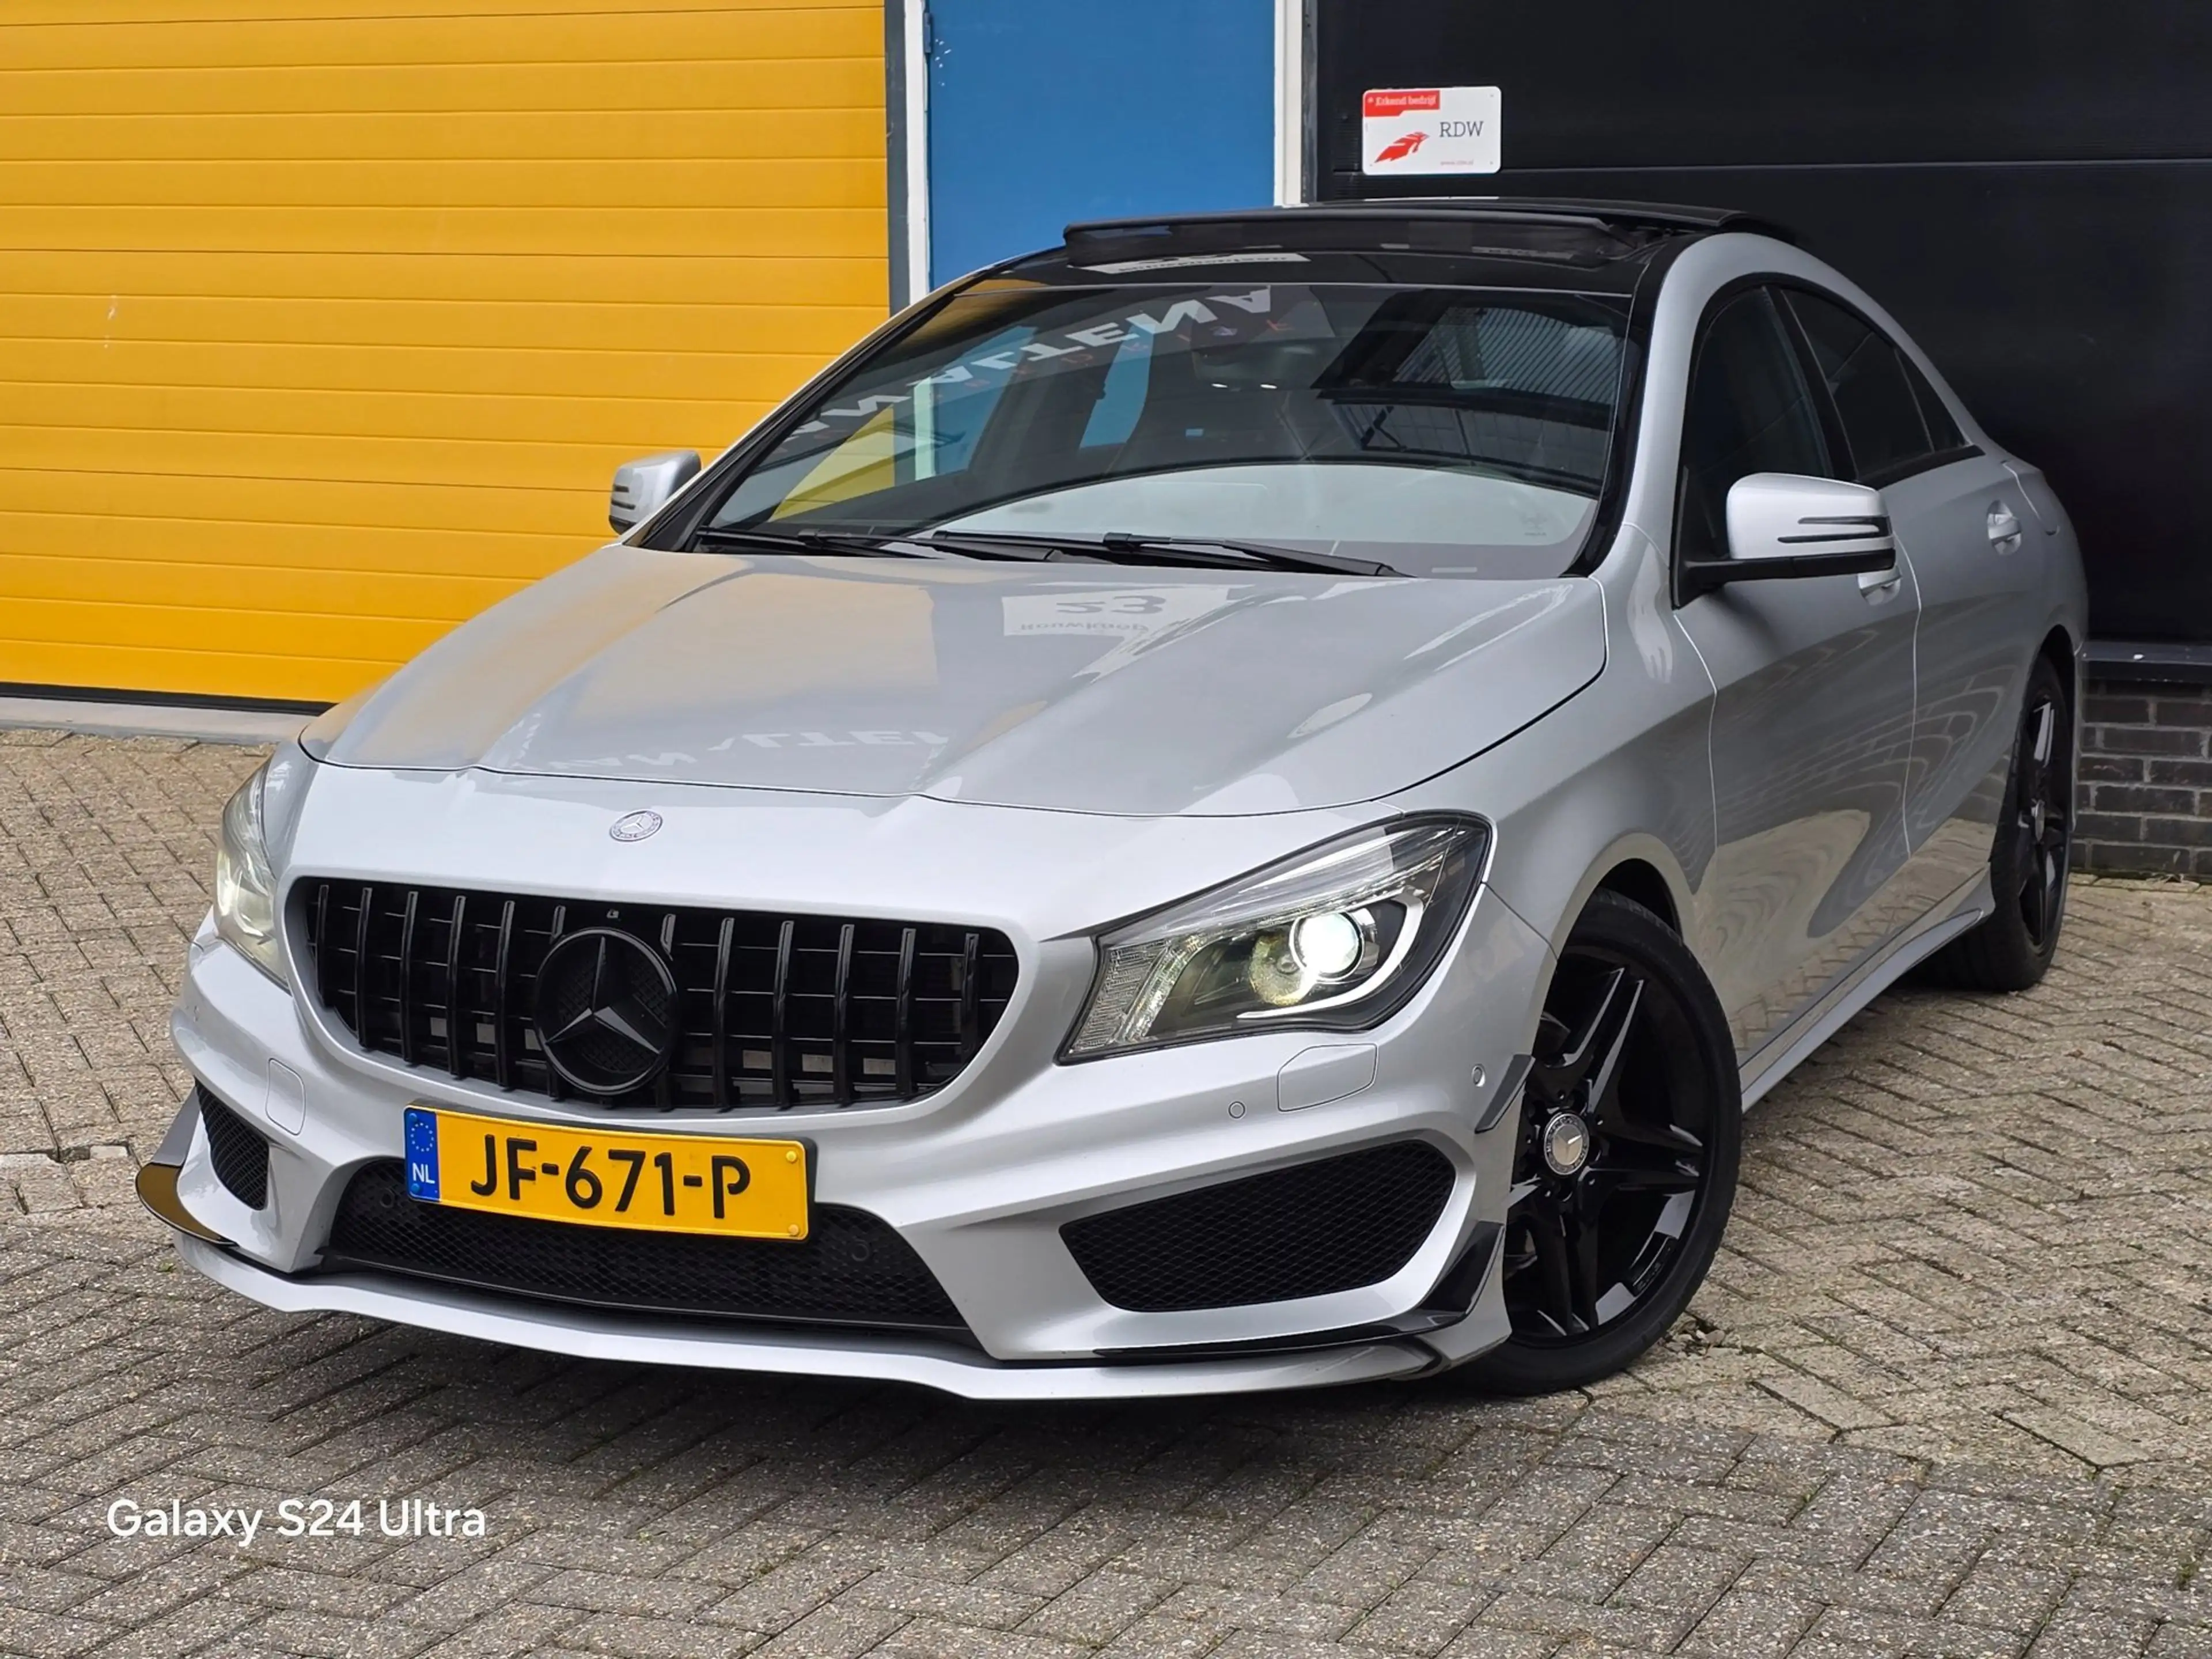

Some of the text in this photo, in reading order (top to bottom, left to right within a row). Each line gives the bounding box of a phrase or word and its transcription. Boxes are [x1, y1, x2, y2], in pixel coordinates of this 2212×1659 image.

[1440, 121, 1484, 138] RDW
[412, 1162, 435, 1184] NL
[470, 1134, 751, 1219] JF-671-P
